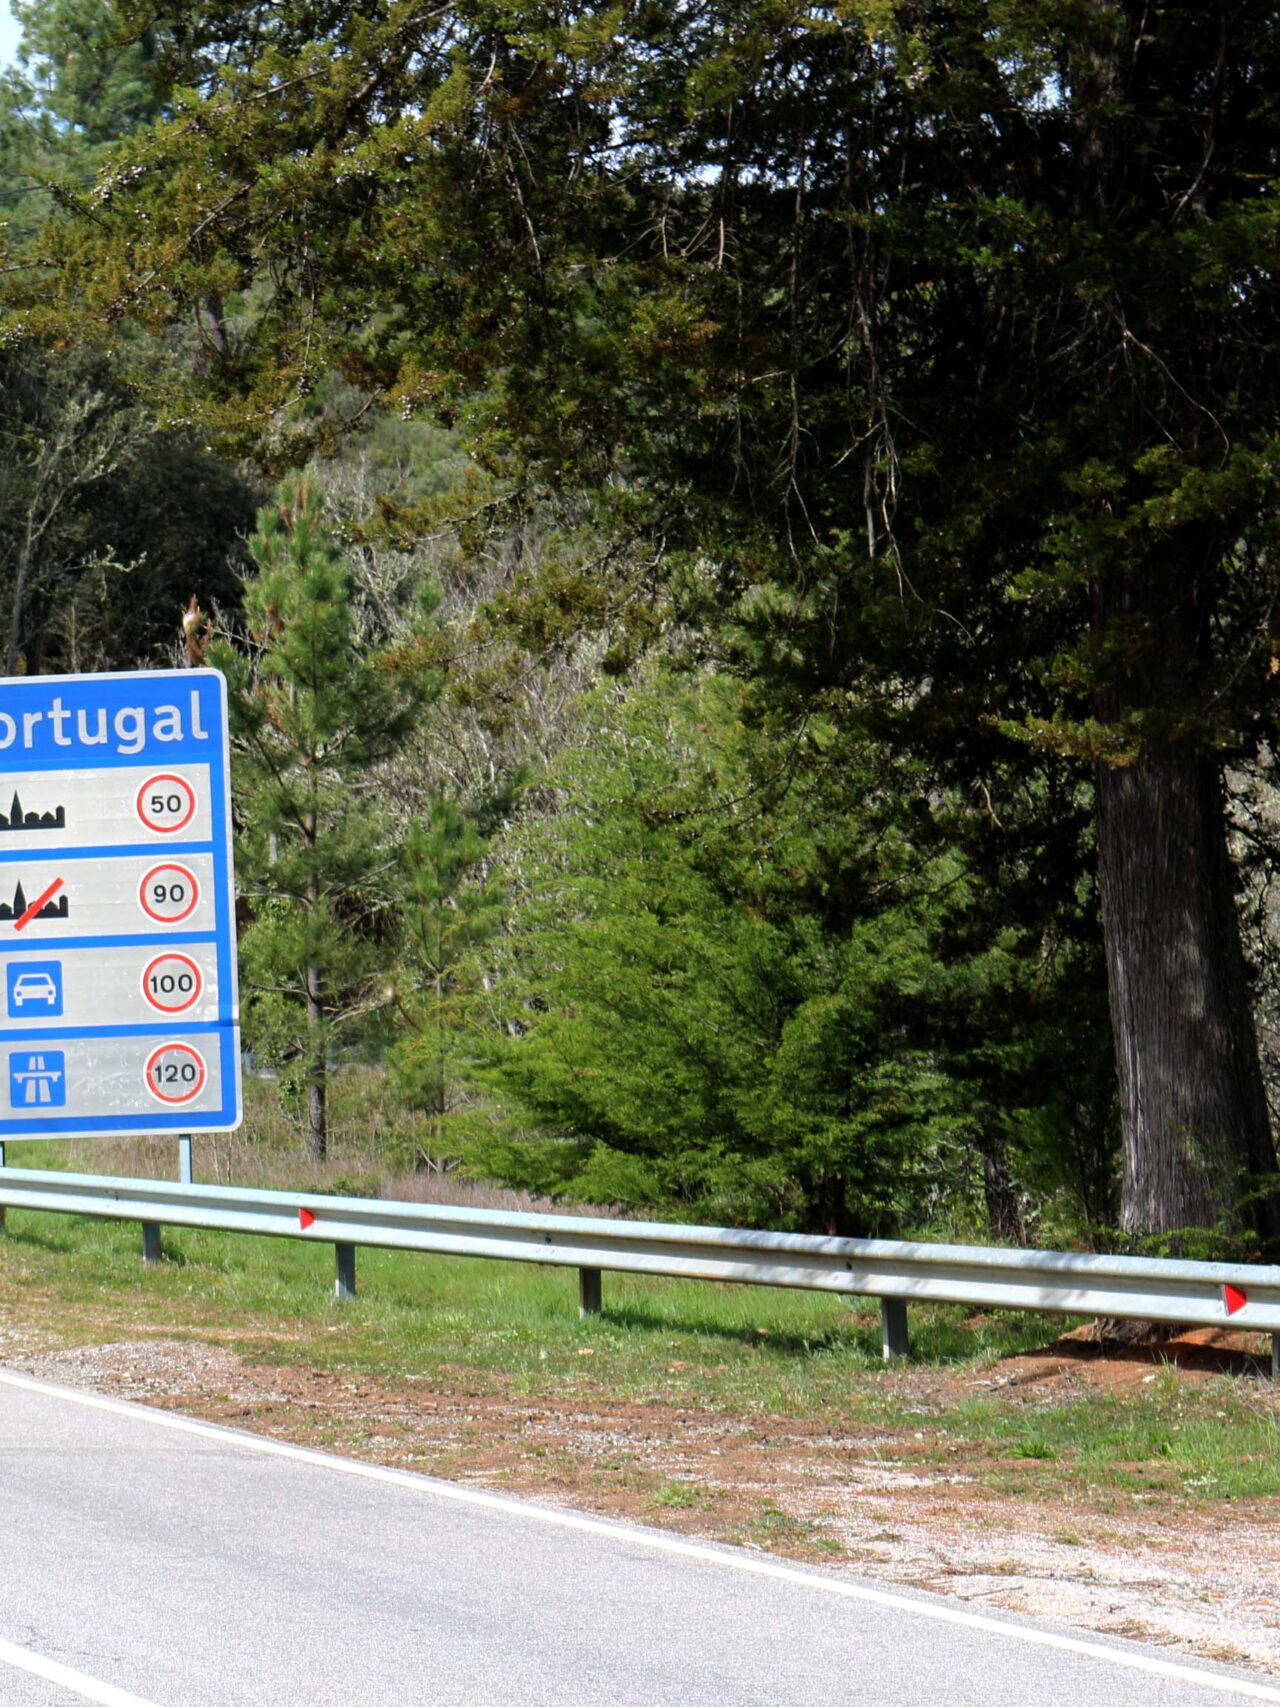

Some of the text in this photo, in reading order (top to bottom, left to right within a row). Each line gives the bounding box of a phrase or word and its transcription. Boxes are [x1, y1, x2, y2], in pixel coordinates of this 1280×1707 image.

[151, 794, 182, 814] 50
[153, 884, 185, 904] 90
[150, 973, 193, 994] 100
[153, 1063, 196, 1084] 120
